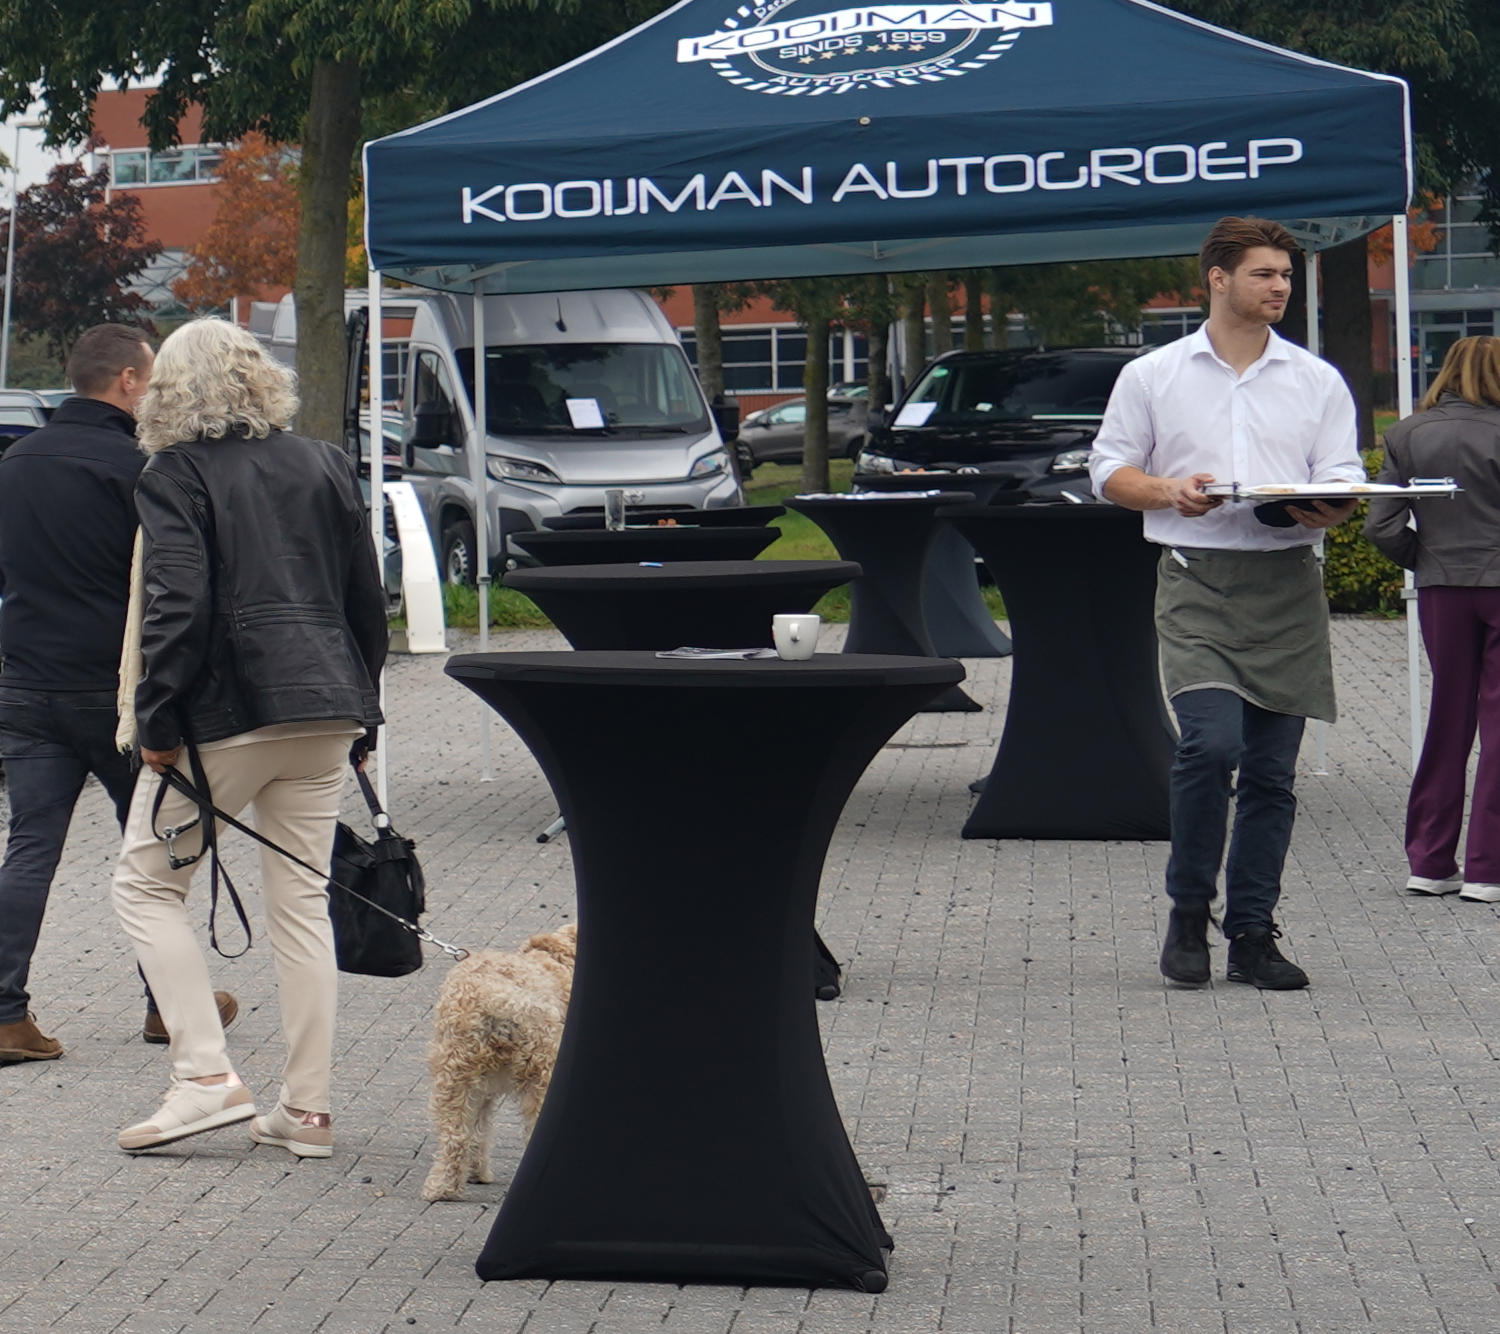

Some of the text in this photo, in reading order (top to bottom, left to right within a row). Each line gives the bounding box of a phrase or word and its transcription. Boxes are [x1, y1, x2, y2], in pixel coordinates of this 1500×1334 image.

[692, 6, 1037, 56] KOOIJMAN
[778, 30, 947, 60] SINDS 1959
[768, 57, 957, 87] AUTOGROEP
[461, 137, 1304, 224] KOOIJMAN AUTOGROEP
